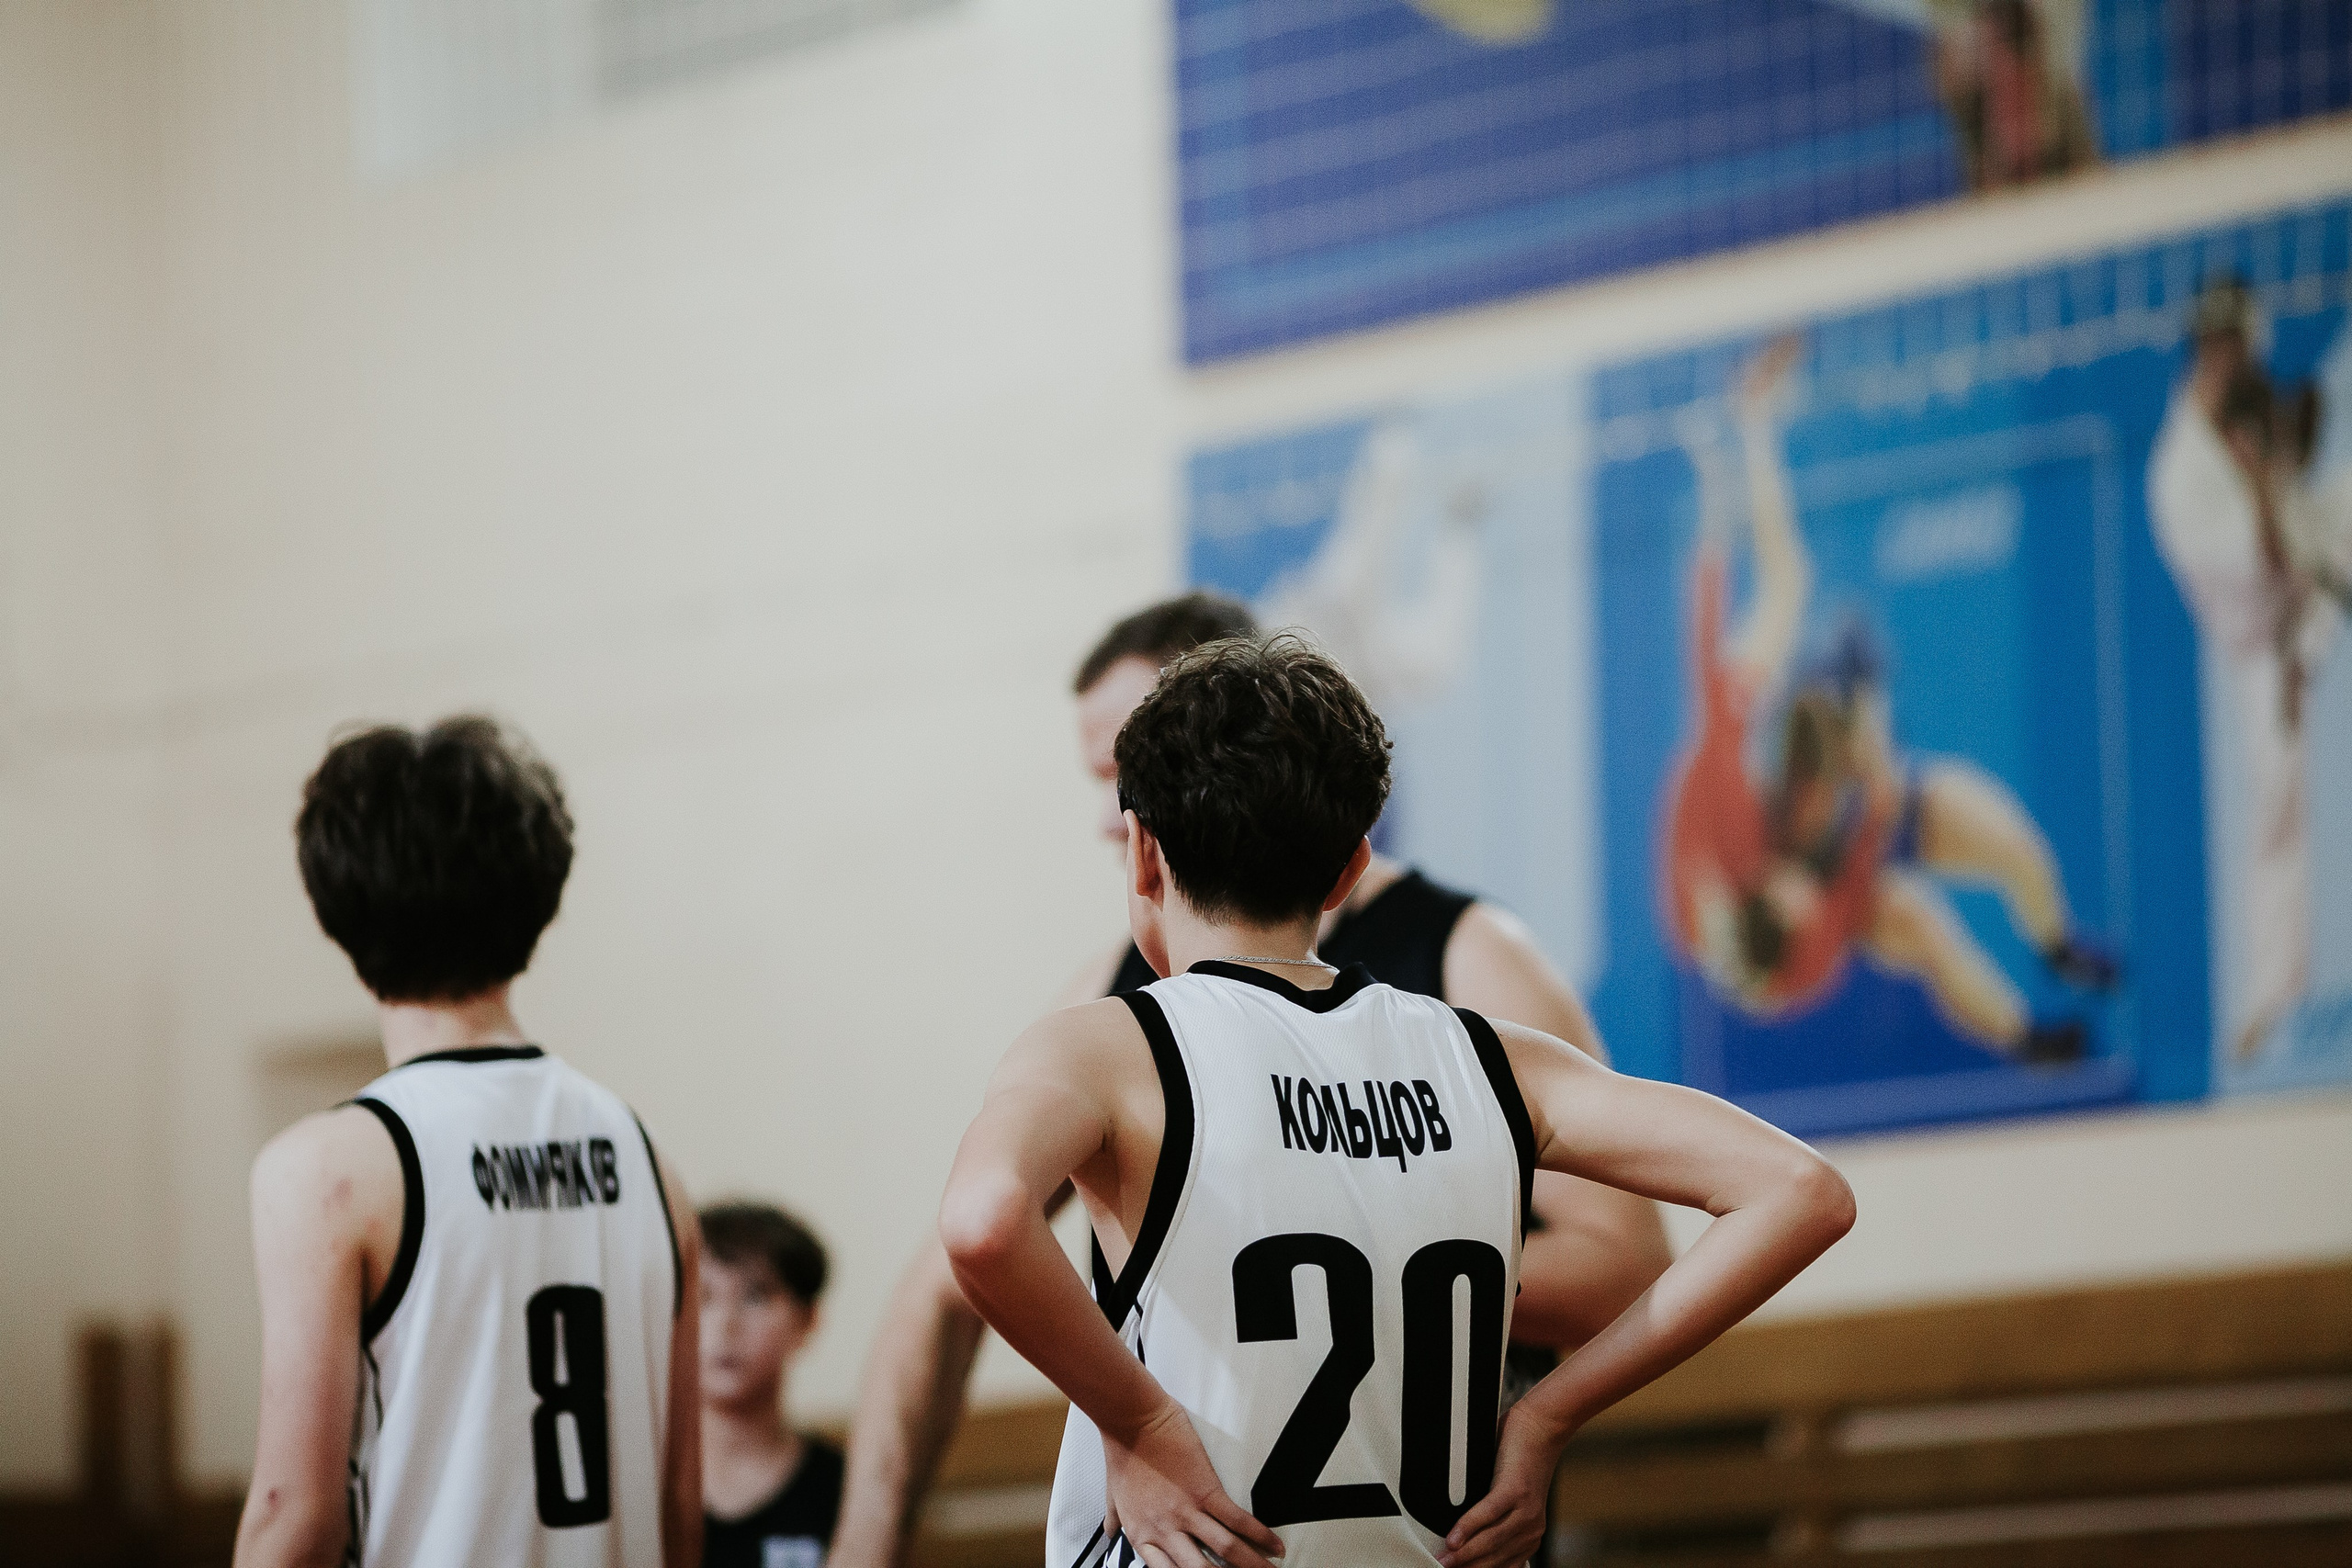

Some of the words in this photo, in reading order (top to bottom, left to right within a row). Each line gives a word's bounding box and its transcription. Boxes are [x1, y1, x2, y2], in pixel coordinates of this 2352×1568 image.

[1270, 1073, 1453, 1174] КОЛЬЦОВ
[526, 1282, 611, 1529] 8
[1232, 1233, 1507, 1539] 20
